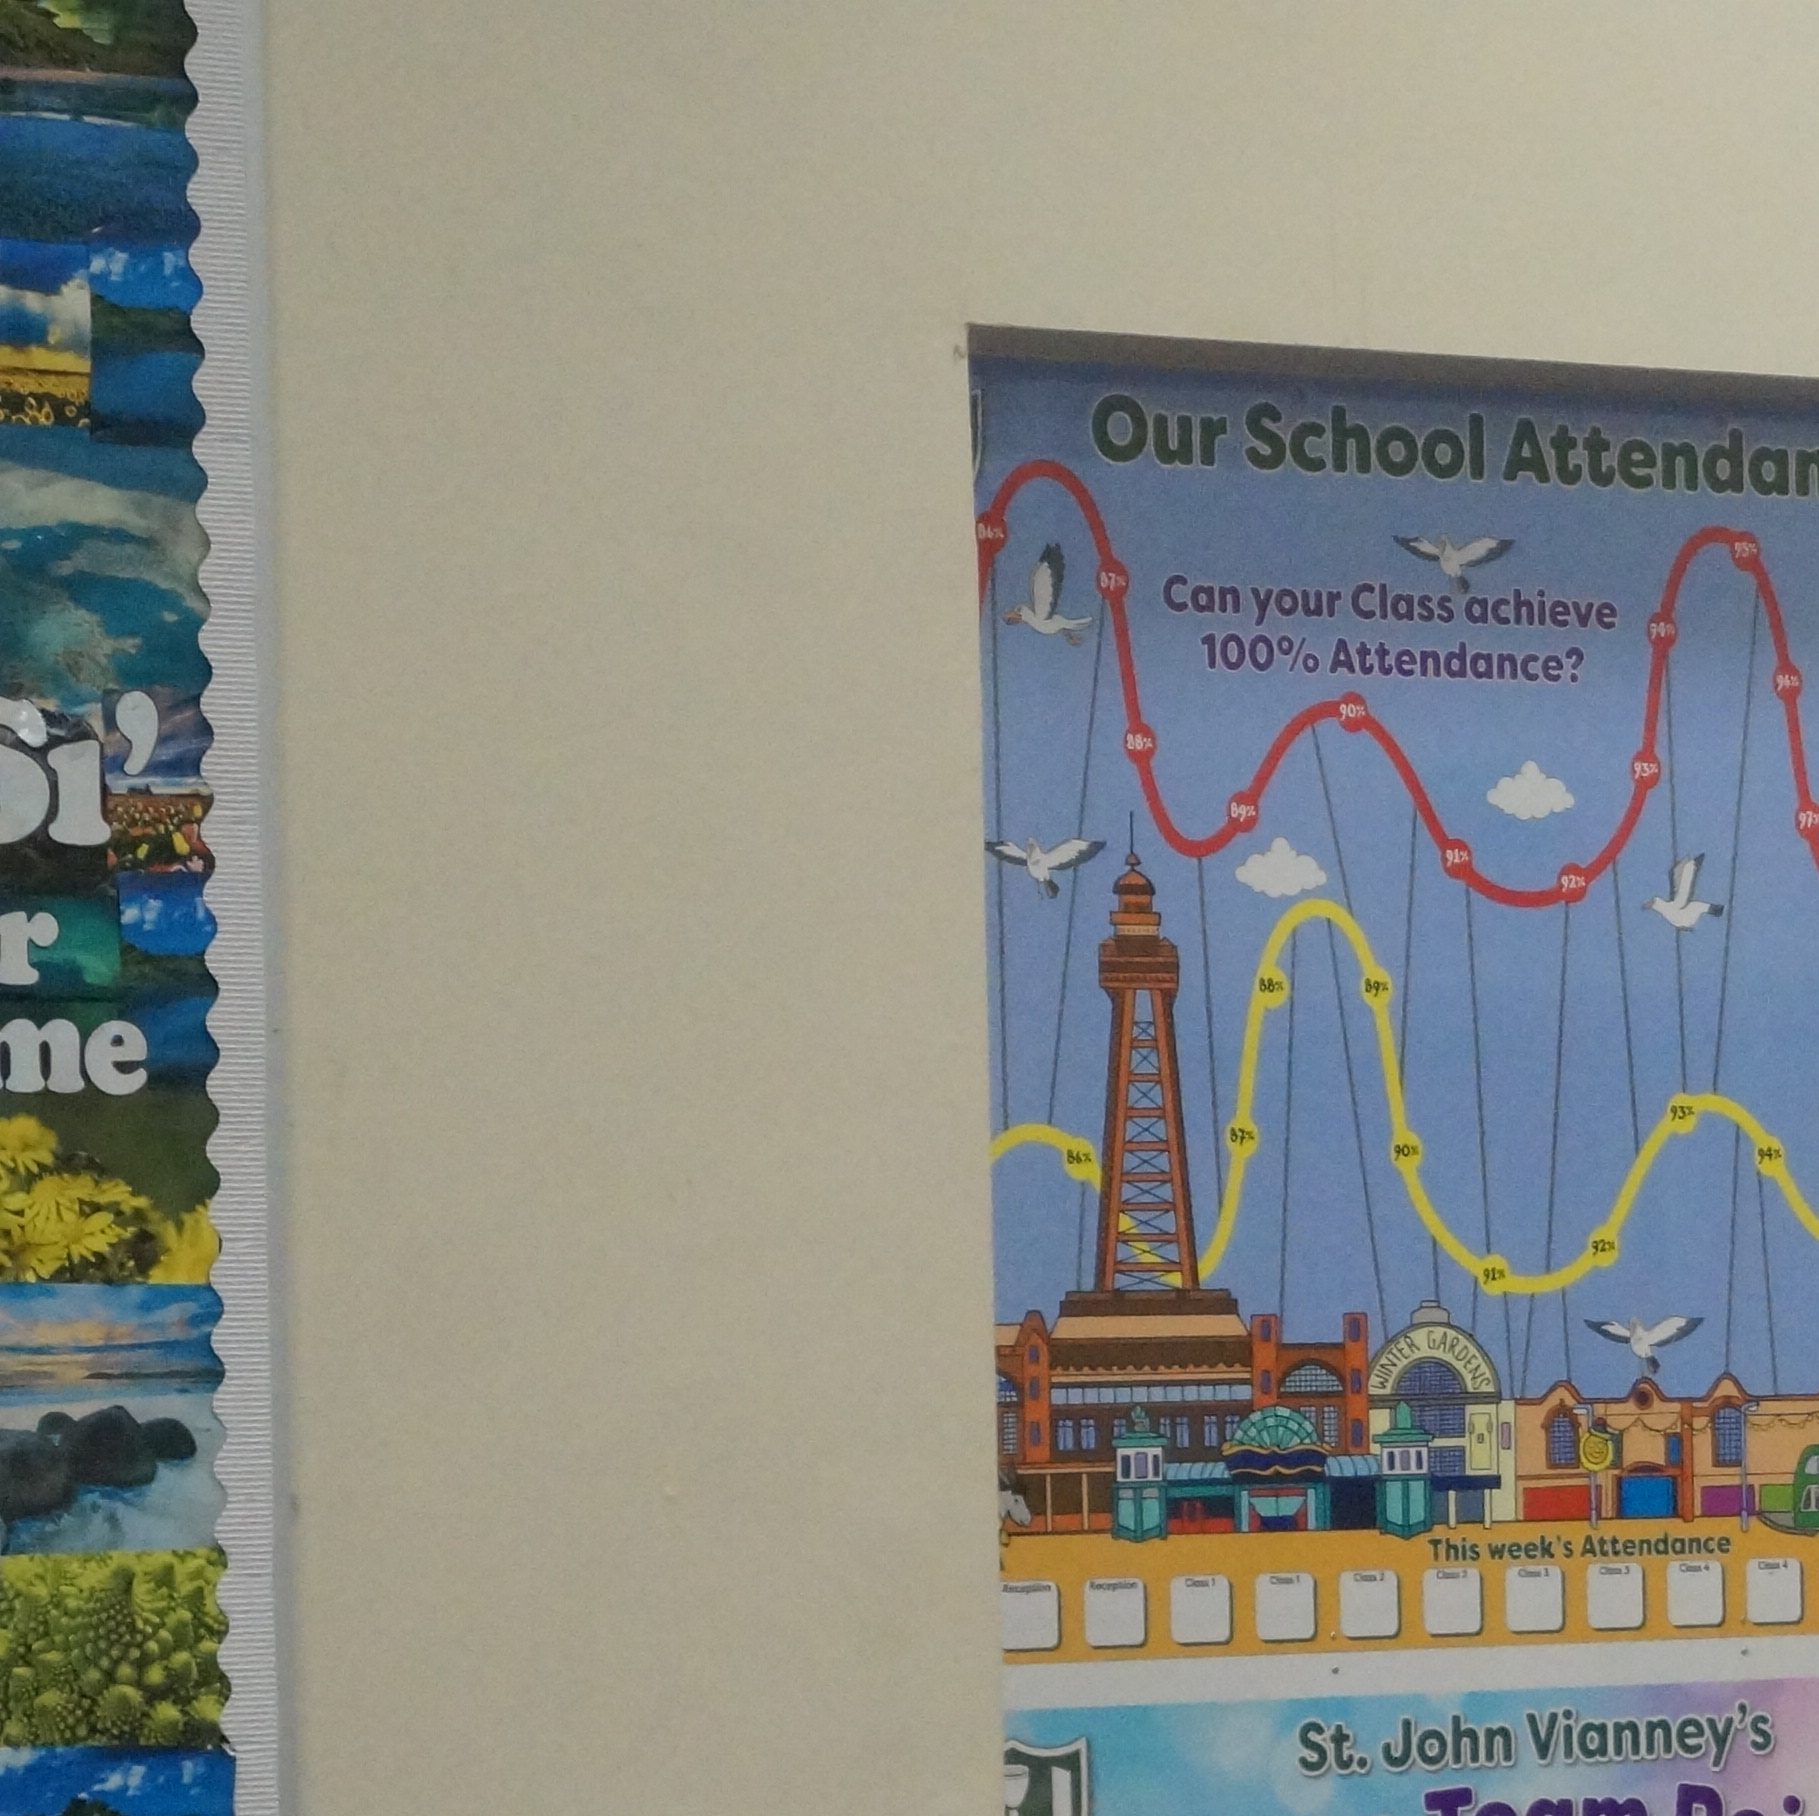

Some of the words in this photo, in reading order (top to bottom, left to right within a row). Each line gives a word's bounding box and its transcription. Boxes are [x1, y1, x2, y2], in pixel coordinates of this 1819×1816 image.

[1091, 394, 1228, 467] Our
[1244, 402, 1486, 482] School
[1734, 542, 1758, 558] 95%
[1101, 573, 1126, 588] 87%
[1163, 575, 1240, 615] Can
[1251, 584, 1341, 625] your
[1351, 582, 1455, 624] Class
[1464, 589, 1617, 629] achieve
[1650, 622, 1675, 639] 94%
[1201, 633, 1319, 673] 100%
[1329, 637, 1584, 683] Attendance?
[1339, 703, 1366, 719] 90%
[1126, 734, 1153, 750] 88%
[1634, 761, 1659, 778] 93%
[1230, 803, 1256, 819] 89%
[1446, 849, 1468, 865] 91%
[1561, 874, 1586, 890] 92%
[1258, 977, 1284, 993] 88%
[1365, 978, 1389, 996] 89%
[1670, 1105, 1694, 1121] 93%
[1230, 1128, 1255, 1144] 87%
[1067, 1149, 1092, 1165] 86%
[1394, 1143, 1420, 1160] 90%
[1758, 1148, 1782, 1164] 94%
[1592, 1240, 1616, 1256] 92%
[1483, 1267, 1505, 1283] 91%
[1370, 1334, 1420, 1390] WINTER
[1427, 1329, 1491, 1390] GARDENS
[1428, 1536, 1480, 1562] This
[1488, 1535, 1573, 1560] week's
[1581, 1532, 1731, 1557] Attendance
[1089, 1580, 1138, 1592] Reception
[1298, 1721, 1370, 1773] St.
[1381, 1714, 1513, 1768] John
[1525, 1702, 1774, 1770] Vianney's
